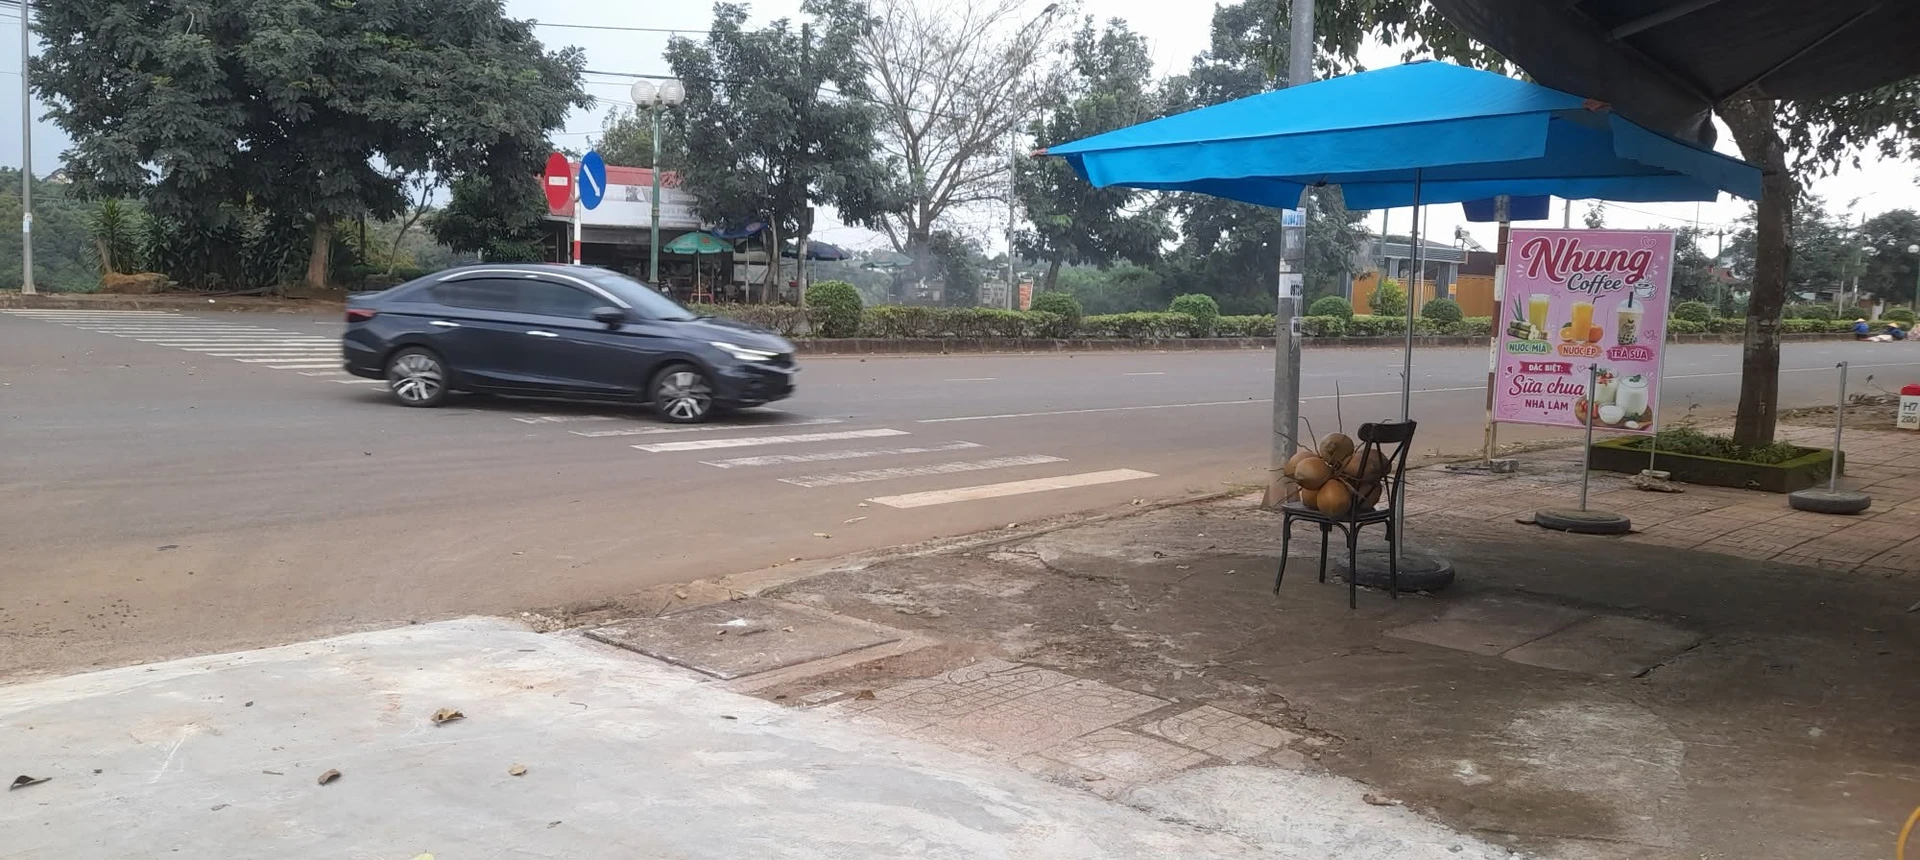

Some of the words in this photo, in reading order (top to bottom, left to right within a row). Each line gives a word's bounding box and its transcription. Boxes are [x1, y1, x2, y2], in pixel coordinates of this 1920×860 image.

[1521, 237, 1652, 284] Nhung
[1567, 273, 1623, 293] Coffee
[1611, 347, 1627, 358] TRÀ
[1509, 374, 1543, 396] Sữa
[1547, 376, 1585, 396] chua
[1525, 399, 1545, 409] NHÀ
[1548, 400, 1569, 411] LÀM
[1903, 402, 1918, 411] H7
